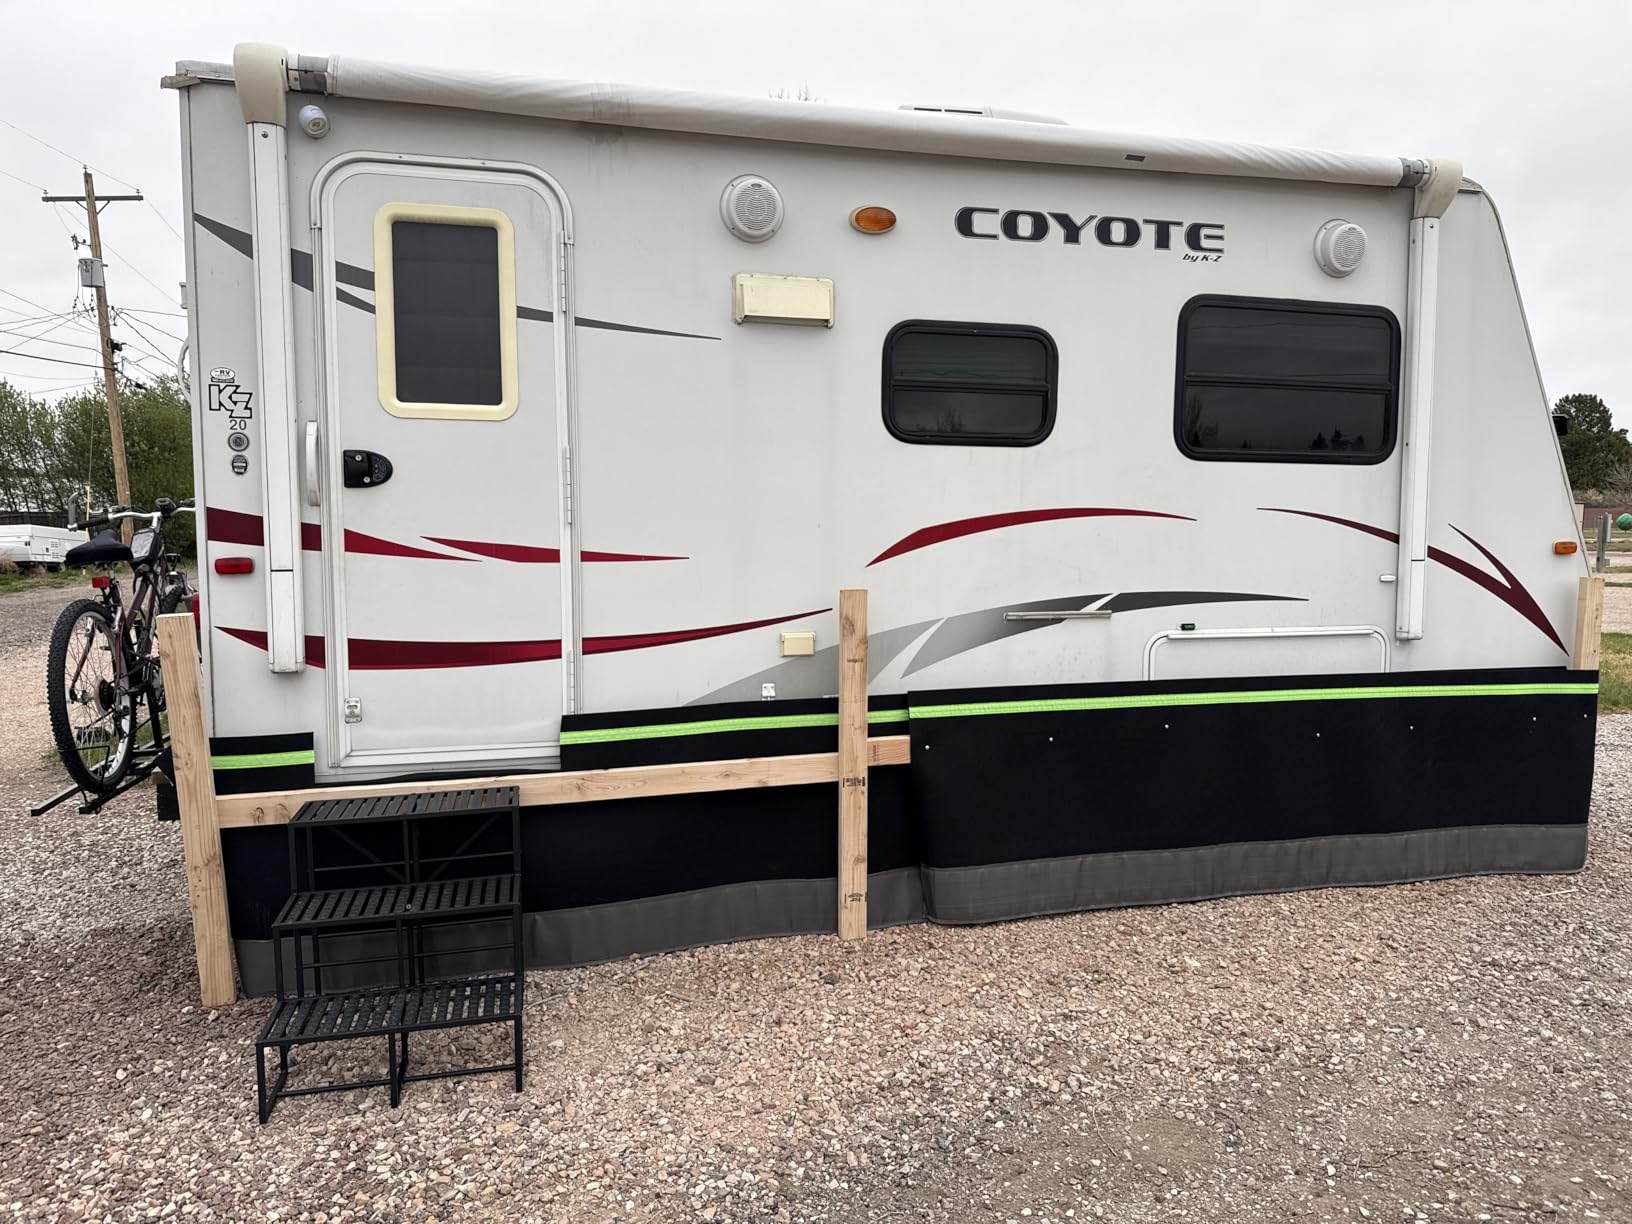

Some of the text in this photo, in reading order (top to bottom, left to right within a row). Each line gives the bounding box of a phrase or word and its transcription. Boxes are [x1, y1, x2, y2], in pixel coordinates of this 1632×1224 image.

[954, 206, 1225, 253] COYOTE
[1182, 253, 1200, 262] by
[229, 419, 247, 431] 20
